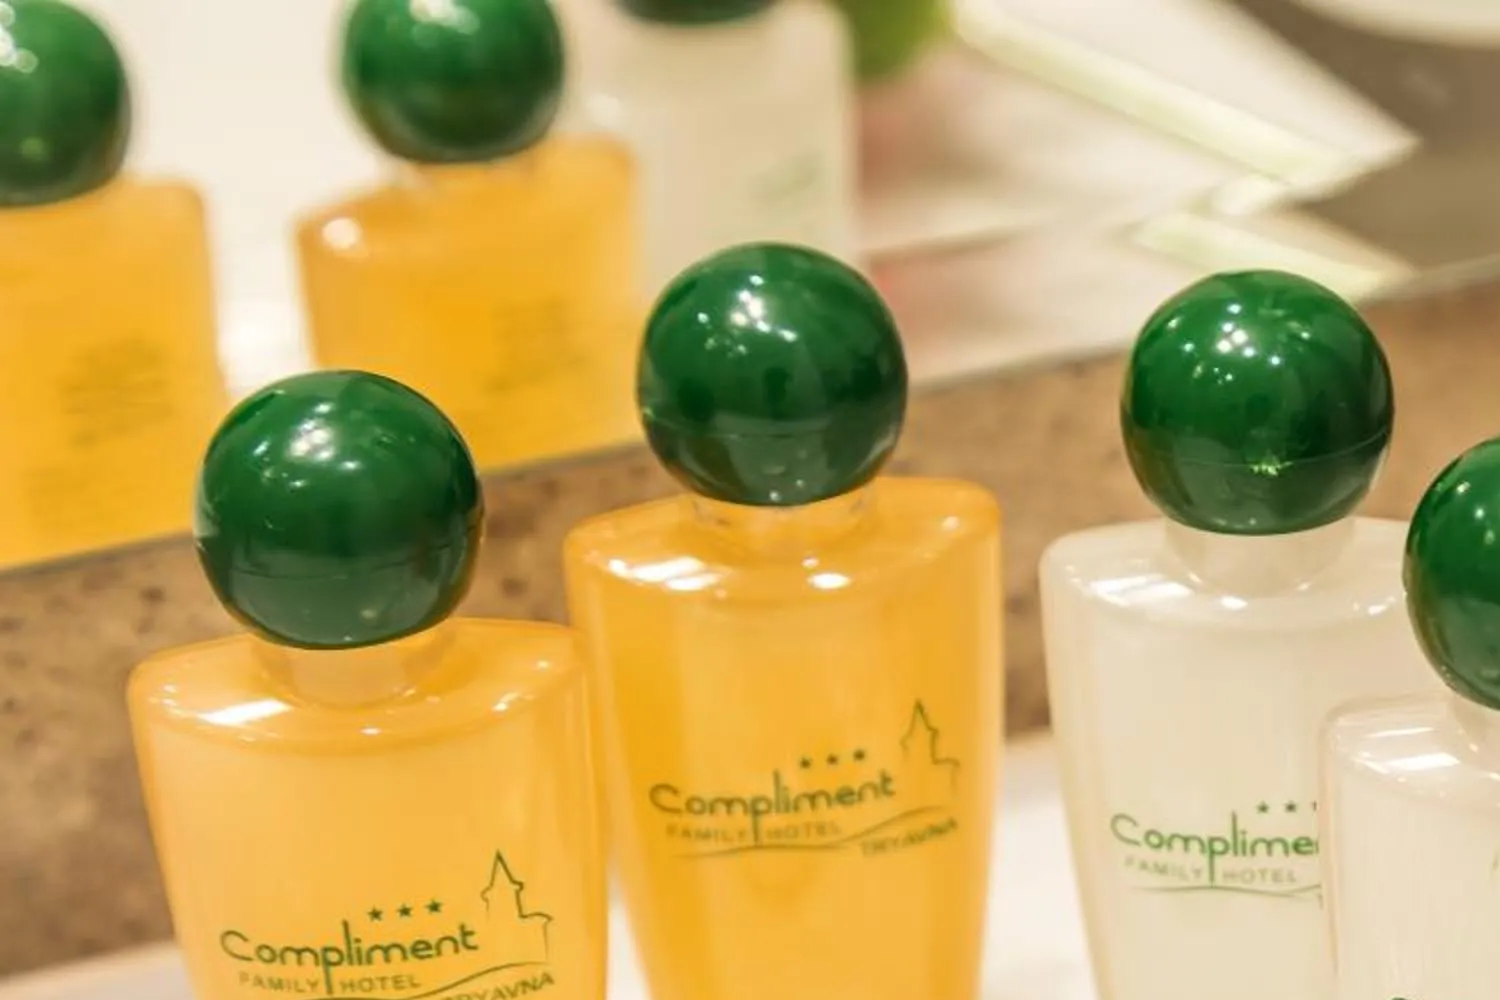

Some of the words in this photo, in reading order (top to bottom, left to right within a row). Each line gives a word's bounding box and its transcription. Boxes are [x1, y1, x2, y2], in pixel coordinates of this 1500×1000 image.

[649, 769, 896, 846] Compliment
[666, 822, 748, 843] FAMILY
[765, 821, 842, 841] HOTEL
[1110, 810, 1320, 884] Complime
[1125, 855, 1204, 880] FAMILY
[1222, 868, 1298, 885] HOTEL
[219, 919, 479, 995] Compliment
[238, 970, 319, 993] FAMILY
[338, 973, 421, 993] HOTEL
